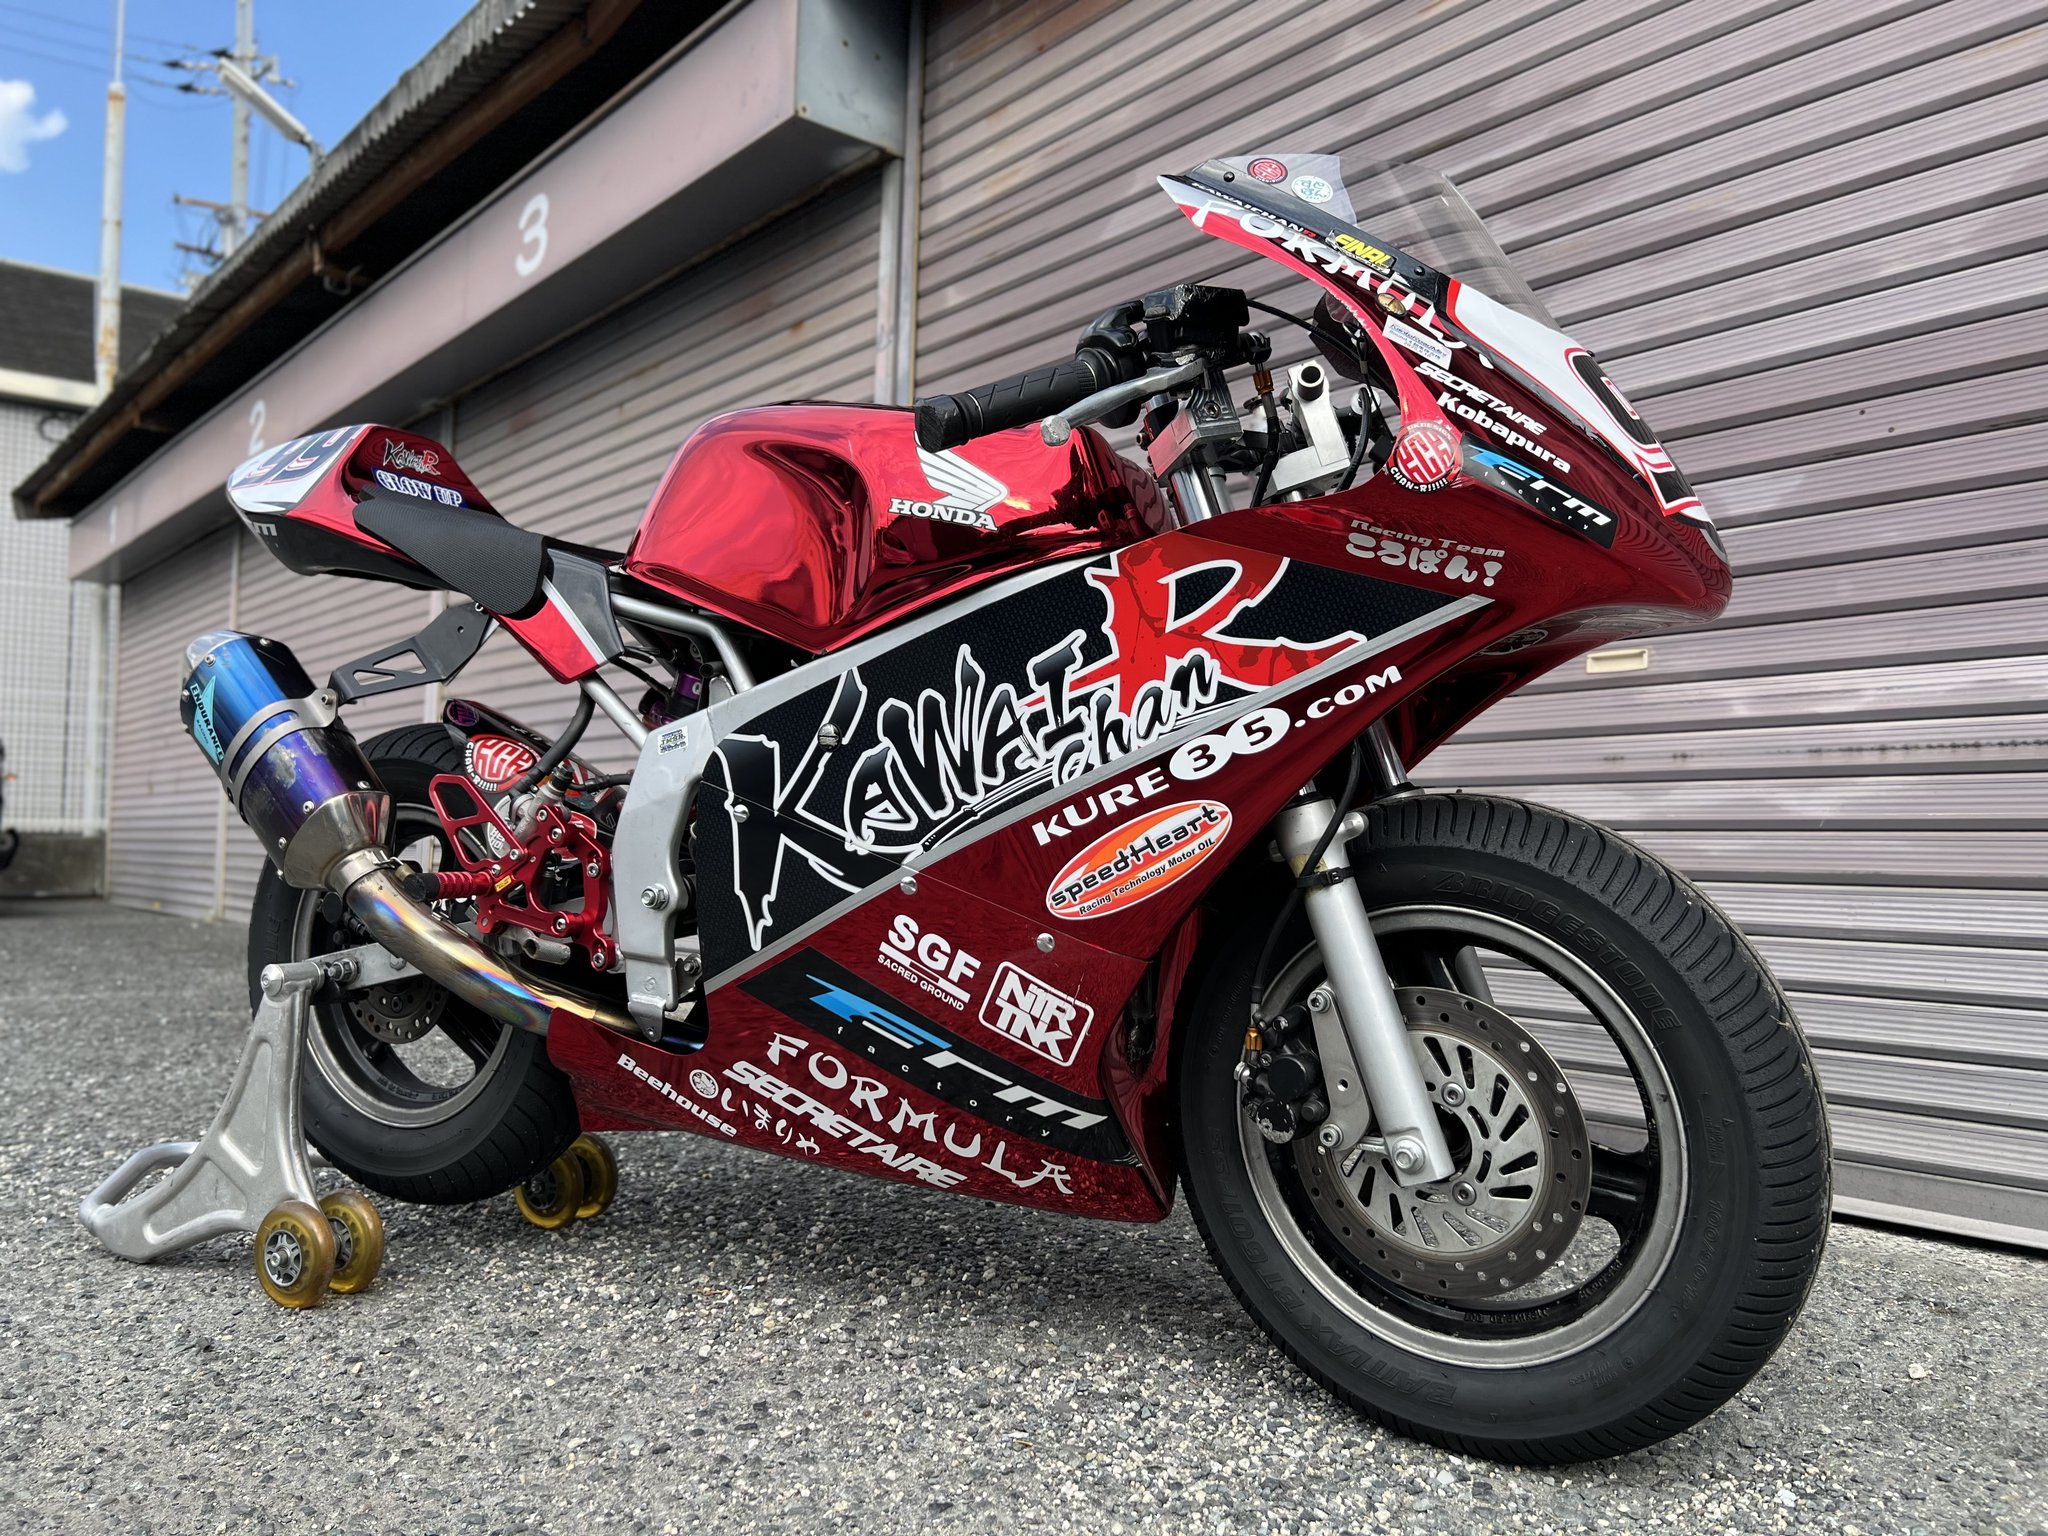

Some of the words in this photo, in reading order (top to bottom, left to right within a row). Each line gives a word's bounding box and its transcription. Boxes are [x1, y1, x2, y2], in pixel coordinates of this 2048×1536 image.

[515, 192, 549, 276] 3
[249, 400, 267, 456] 2
[1413, 361, 1548, 436] SECRETAIRE
[1436, 391, 1571, 474] Kobapura
[375, 469, 432, 501] GLOW
[433, 484, 463, 507] UP
[888, 497, 999, 533] HONDA
[1345, 532, 1503, 587] ころぱん!
[1350, 519, 1433, 548] Racing
[1437, 538, 1506, 558] Team
[190, 682, 225, 761] ENDURANCE
[1079, 893, 1112, 915] Racing
[1112, 863, 1167, 897] Technology
[1168, 848, 1196, 869] Motor
[1197, 837, 1217, 852] OIL
[877, 954, 918, 985] SACRED
[919, 979, 965, 1012] GROUND
[888, 914, 982, 984] SGF
[1432, 869, 1683, 1030] BRIDGESTONE
[616, 1053, 738, 1138] Beehouse
[720, 1087, 821, 1157] いまりや
[766, 1032, 1075, 1195] FORMULA
